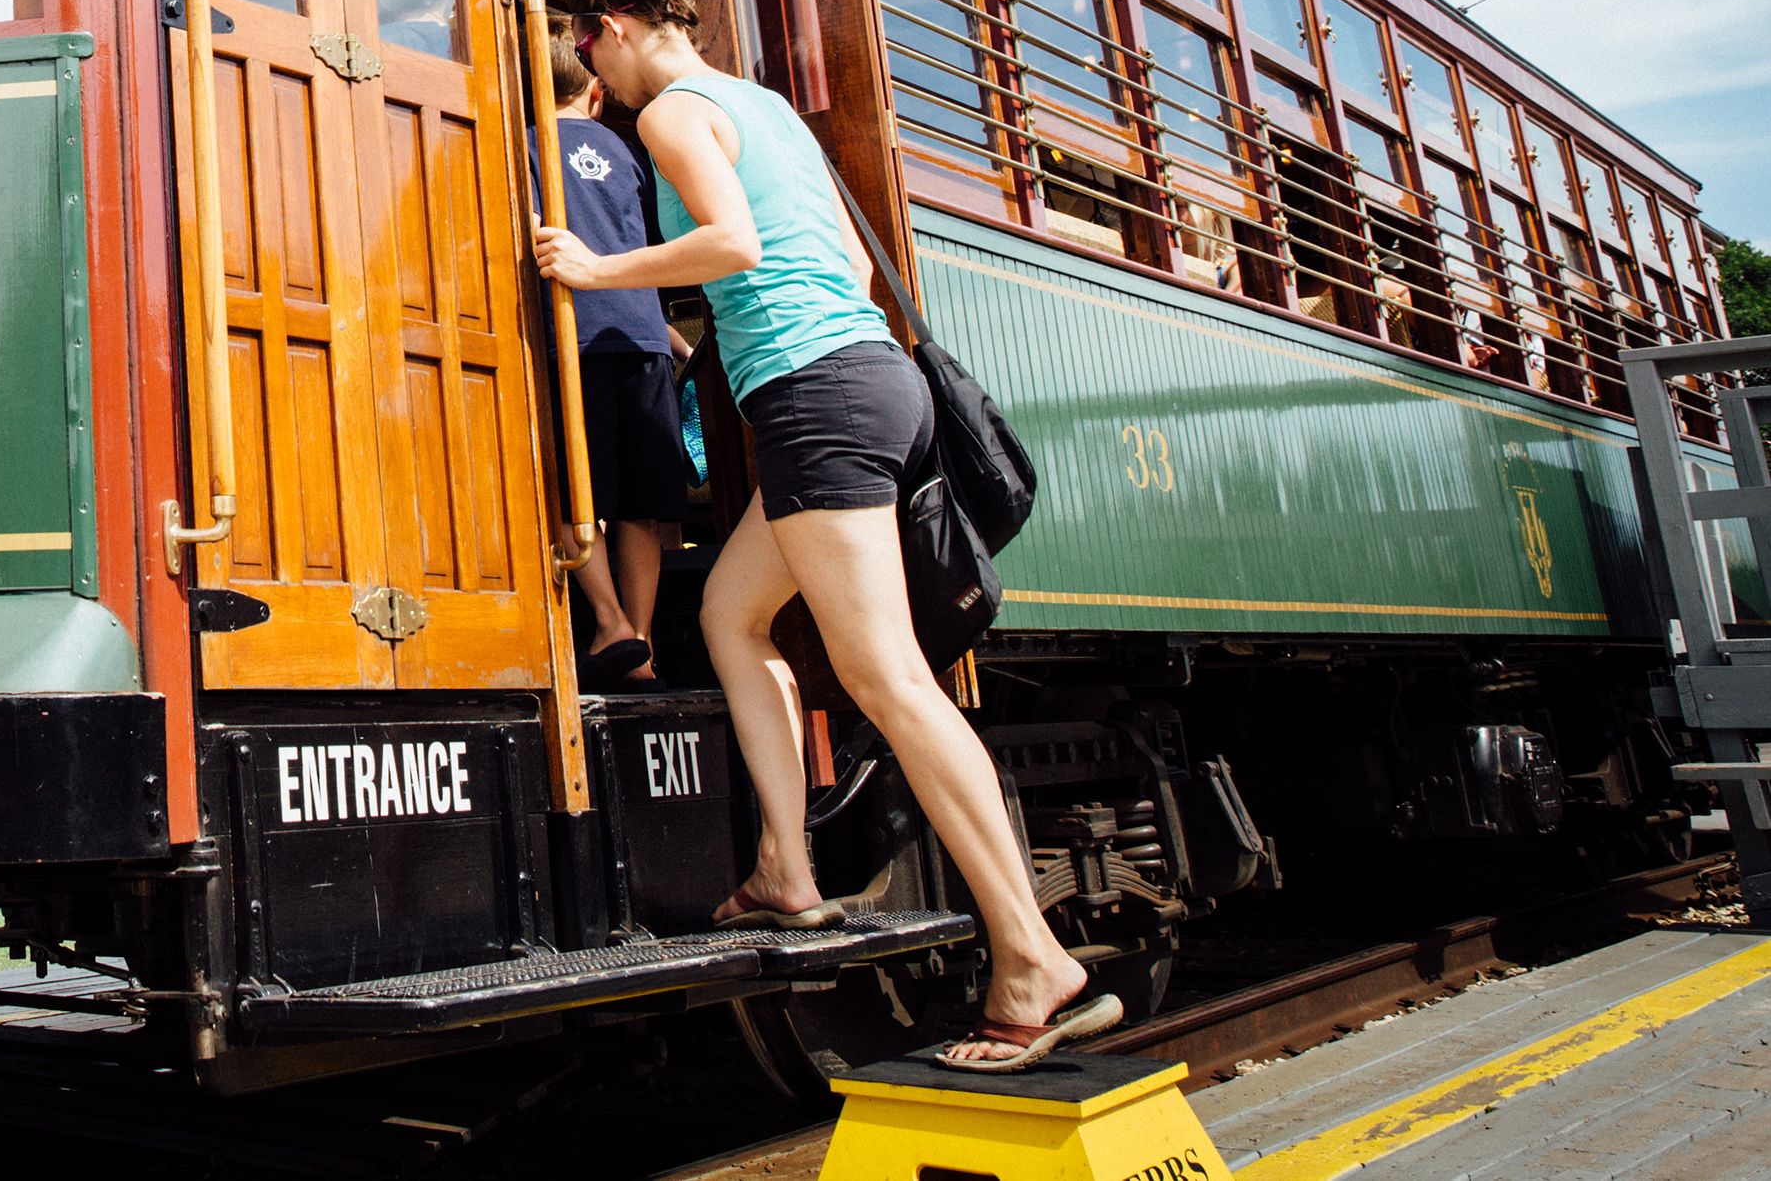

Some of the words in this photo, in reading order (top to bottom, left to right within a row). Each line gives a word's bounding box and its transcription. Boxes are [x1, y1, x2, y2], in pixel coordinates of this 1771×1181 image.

[1122, 425, 1174, 493] 33
[278, 741, 472, 823] ENTRANCE
[643, 731, 702, 797] EXIT
